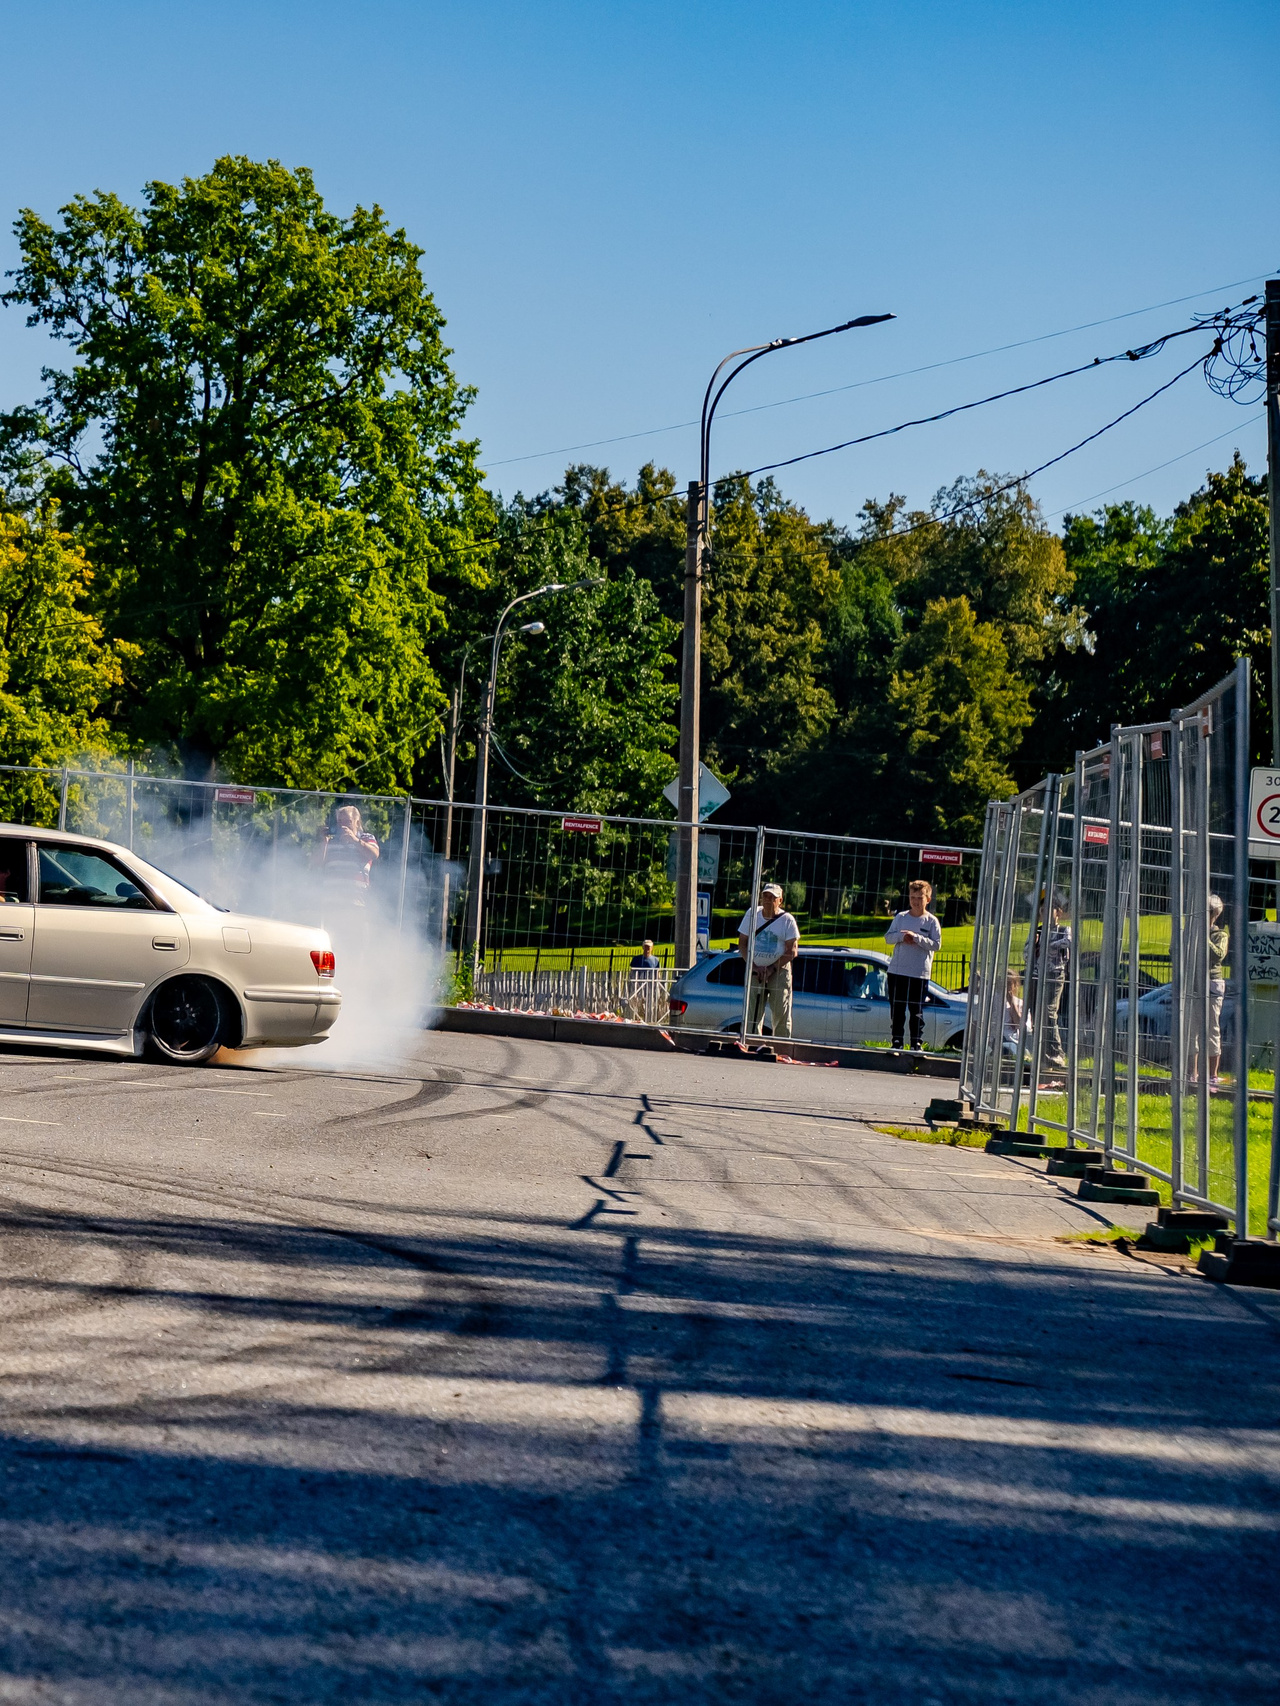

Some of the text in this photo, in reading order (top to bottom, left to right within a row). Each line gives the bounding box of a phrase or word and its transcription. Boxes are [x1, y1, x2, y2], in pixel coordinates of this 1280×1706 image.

[218, 792, 253, 800] RENTALFENCE
[564, 821, 599, 830] RENTALFENCE
[923, 853, 959, 861] RENTALFENCE
